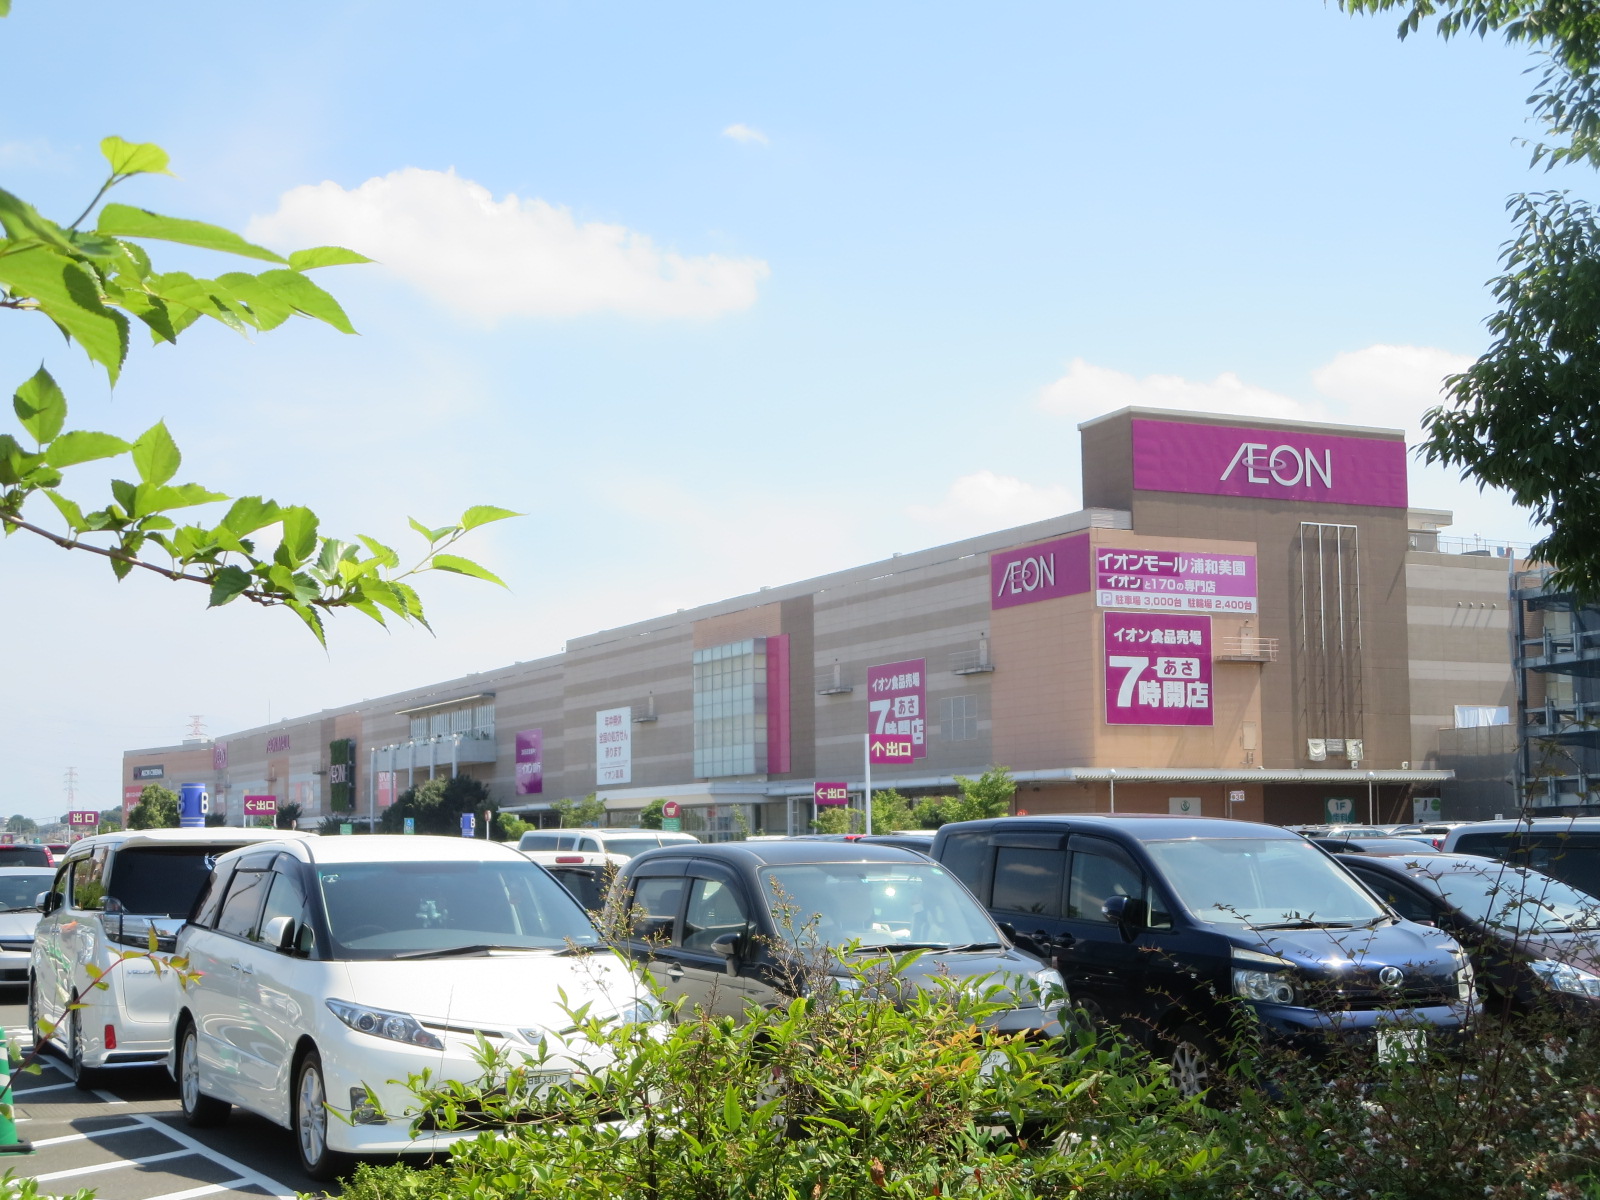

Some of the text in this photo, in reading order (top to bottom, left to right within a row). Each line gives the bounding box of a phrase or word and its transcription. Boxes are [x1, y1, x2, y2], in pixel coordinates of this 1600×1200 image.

[1114, 628, 1202, 645] イオン食品売場
[1163, 660, 1193, 676] あさ
[886, 741, 911, 757] 出口
[827, 788, 847, 799] 出口
[201, 792, 209, 814] B
[256, 800, 275, 811] 出口
[73, 812, 95, 824] 出口
